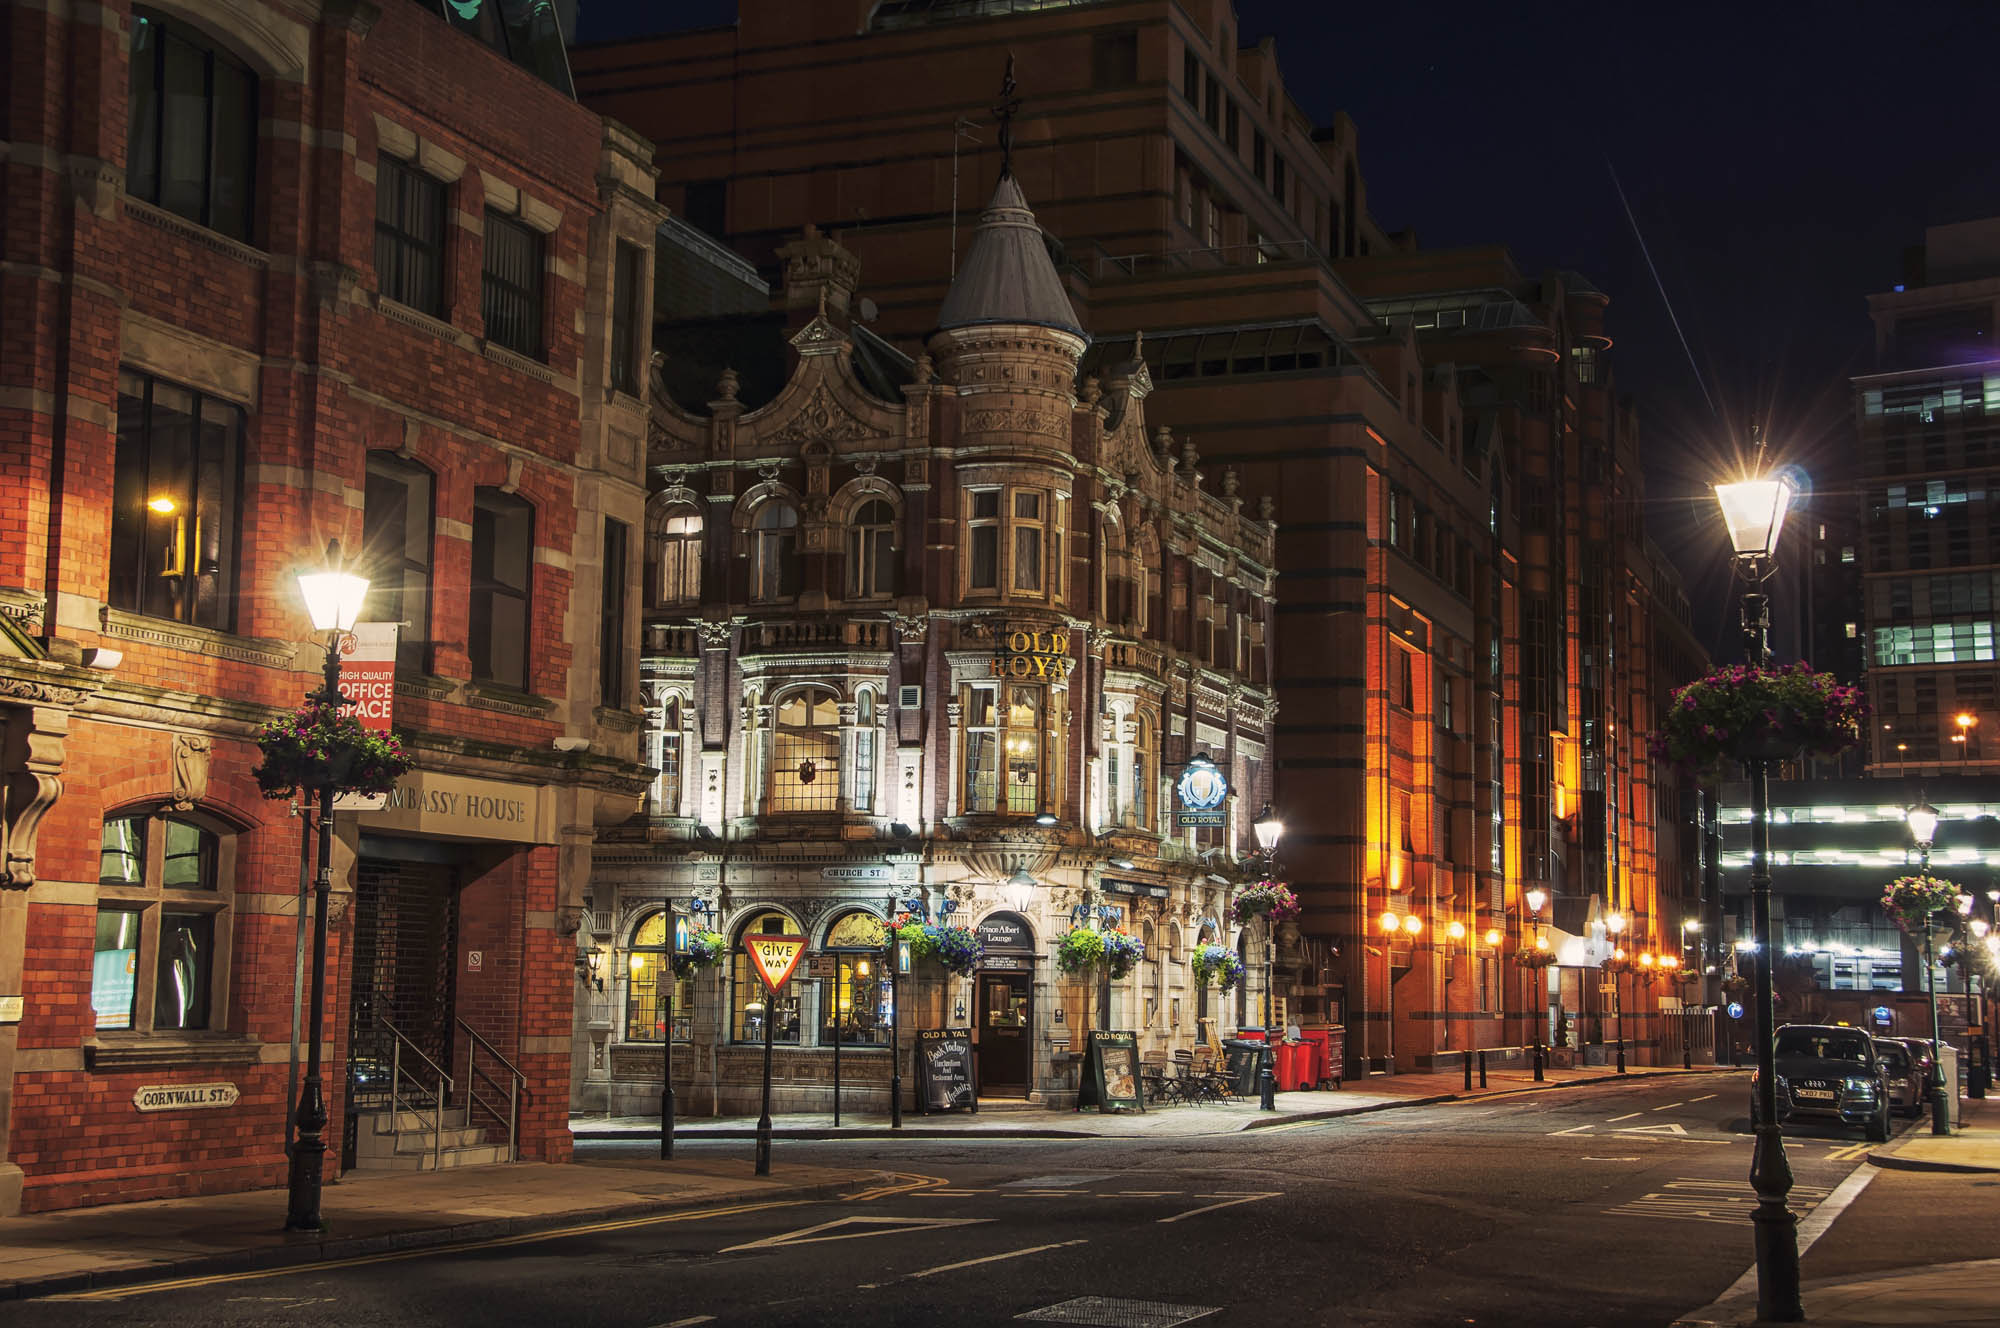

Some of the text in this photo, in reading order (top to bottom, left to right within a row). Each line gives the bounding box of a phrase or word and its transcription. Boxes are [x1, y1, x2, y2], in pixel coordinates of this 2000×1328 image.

[1009, 631, 1067, 655] OLD
[338, 671, 393, 682] HIGH QUALITY
[338, 682, 393, 699] OFFICE
[386, 787, 526, 823] MBASSY HOUSE
[1181, 816, 1222, 824] OLD ROYAL
[828, 869, 863, 877] CHURCH
[870, 869, 881, 877] ST
[978, 925, 1020, 934] Prince Albert
[987, 934, 1012, 944] Lounge
[762, 944, 793, 957] GIVE
[764, 959, 789, 968] WAY
[922, 1031, 940, 1039] OLD
[1111, 1033, 1134, 1041] ROYAL
[927, 1041, 966, 1064] Book Today
[143, 1089, 206, 1106] CORNWALL
[209, 1088, 225, 1102] ST
